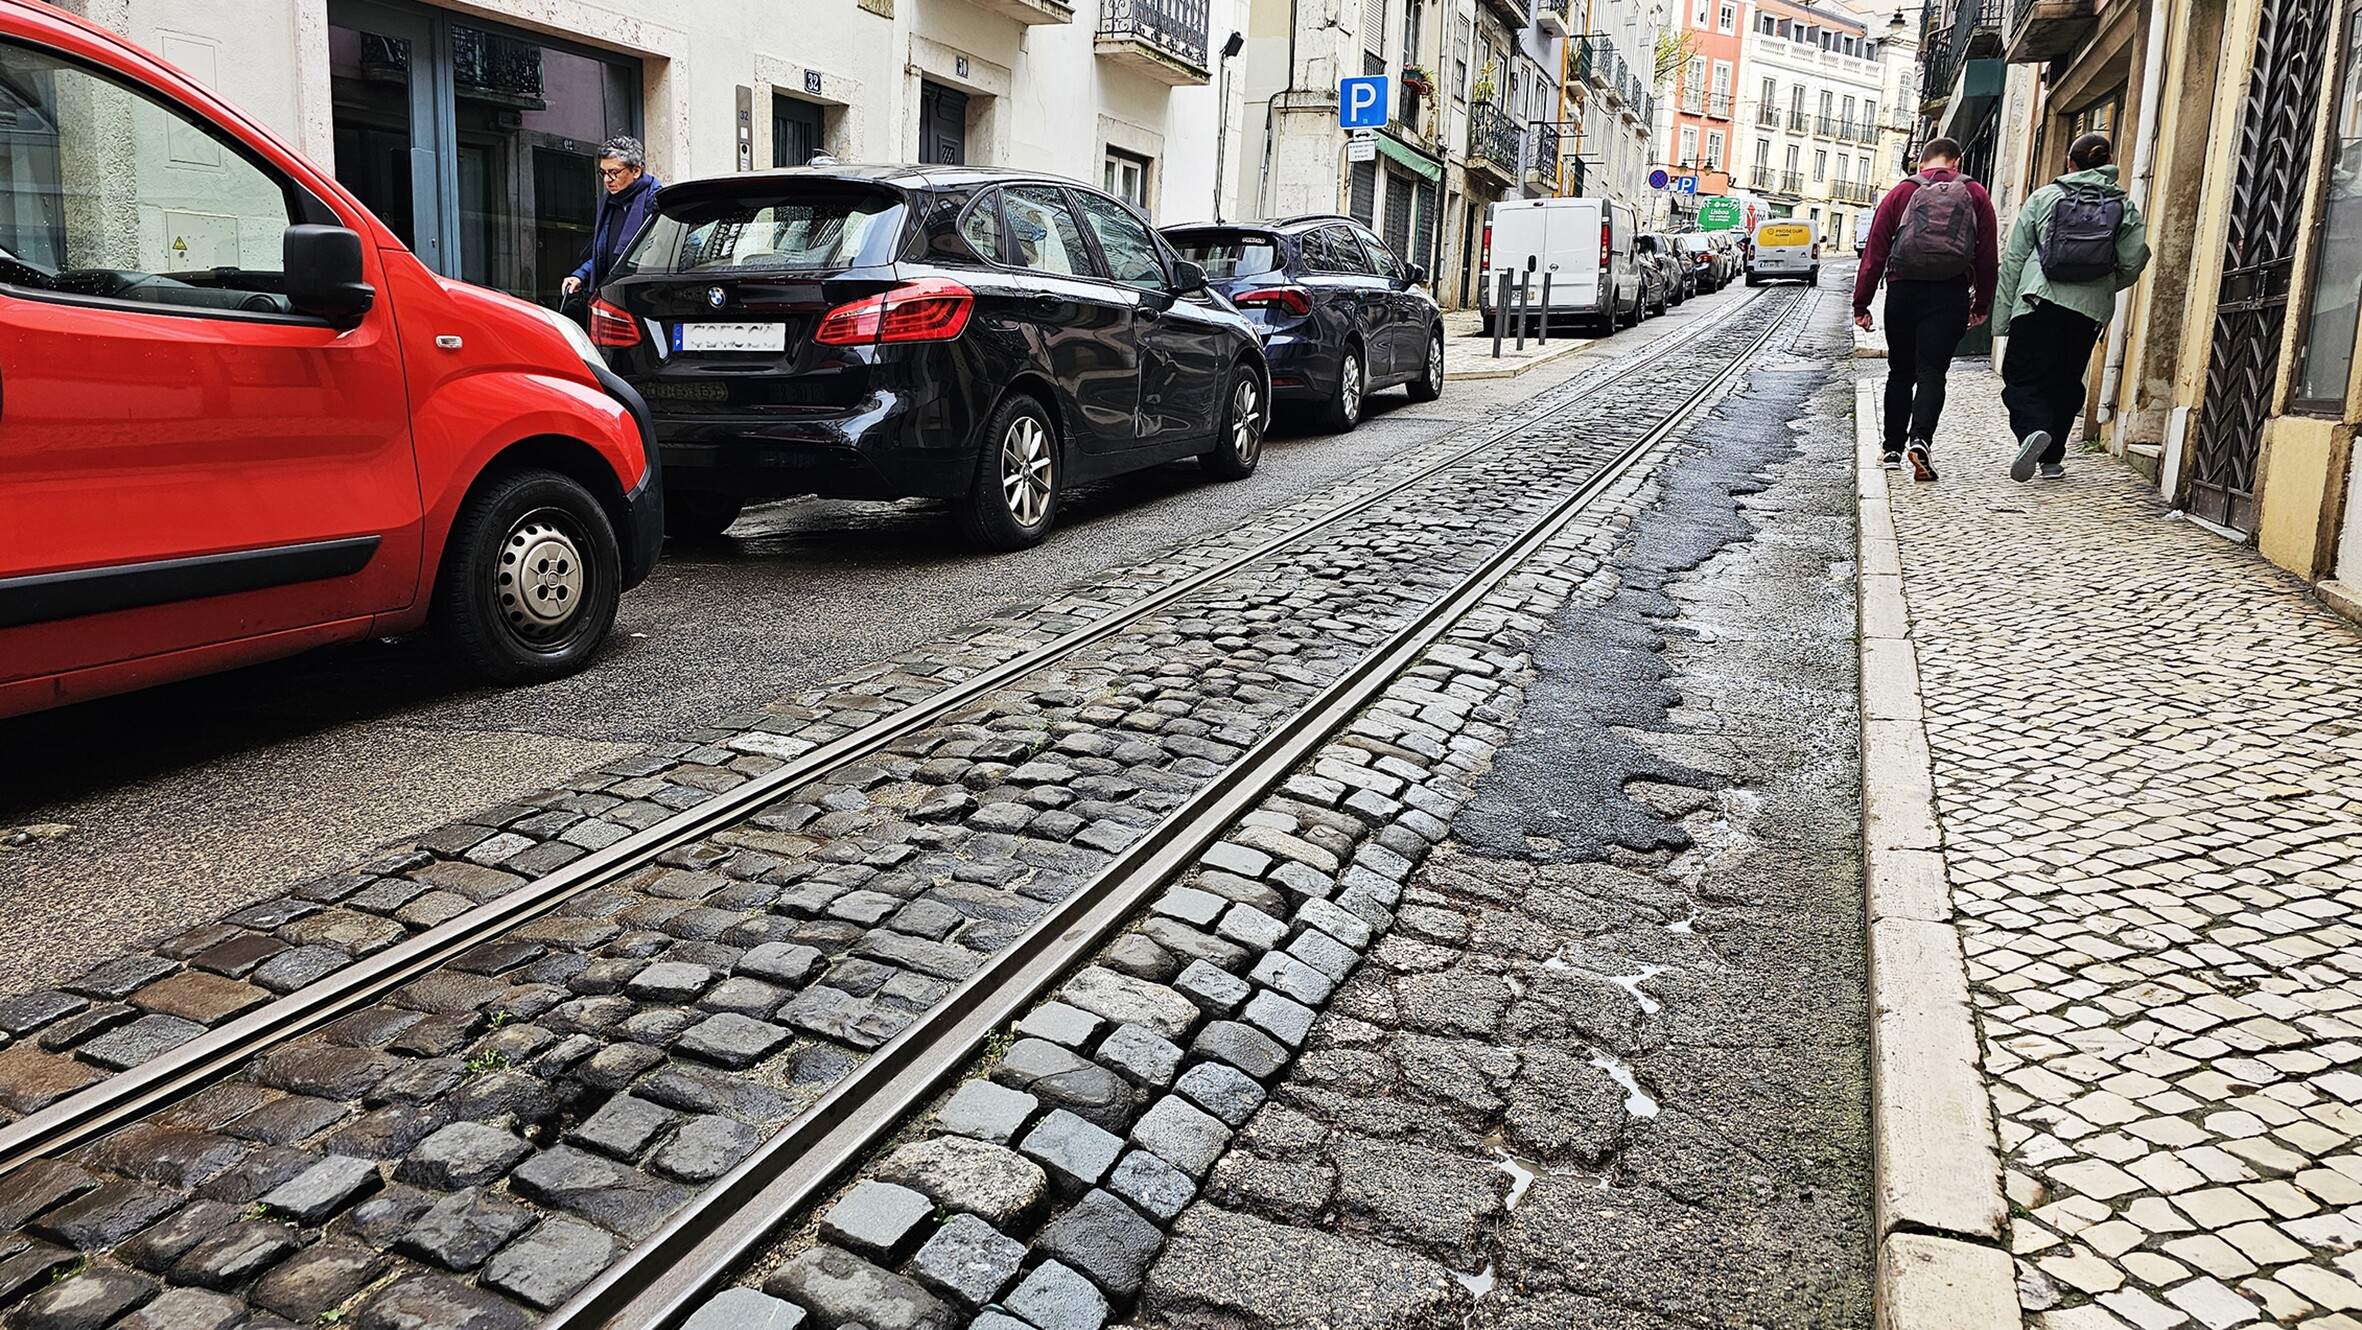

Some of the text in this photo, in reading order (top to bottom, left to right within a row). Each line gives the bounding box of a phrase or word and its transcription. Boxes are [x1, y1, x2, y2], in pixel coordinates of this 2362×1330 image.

[807, 73, 819, 91] 32
[1351, 82, 1376, 122] P
[740, 110, 749, 121] 32
[1681, 178, 1692, 192] P
